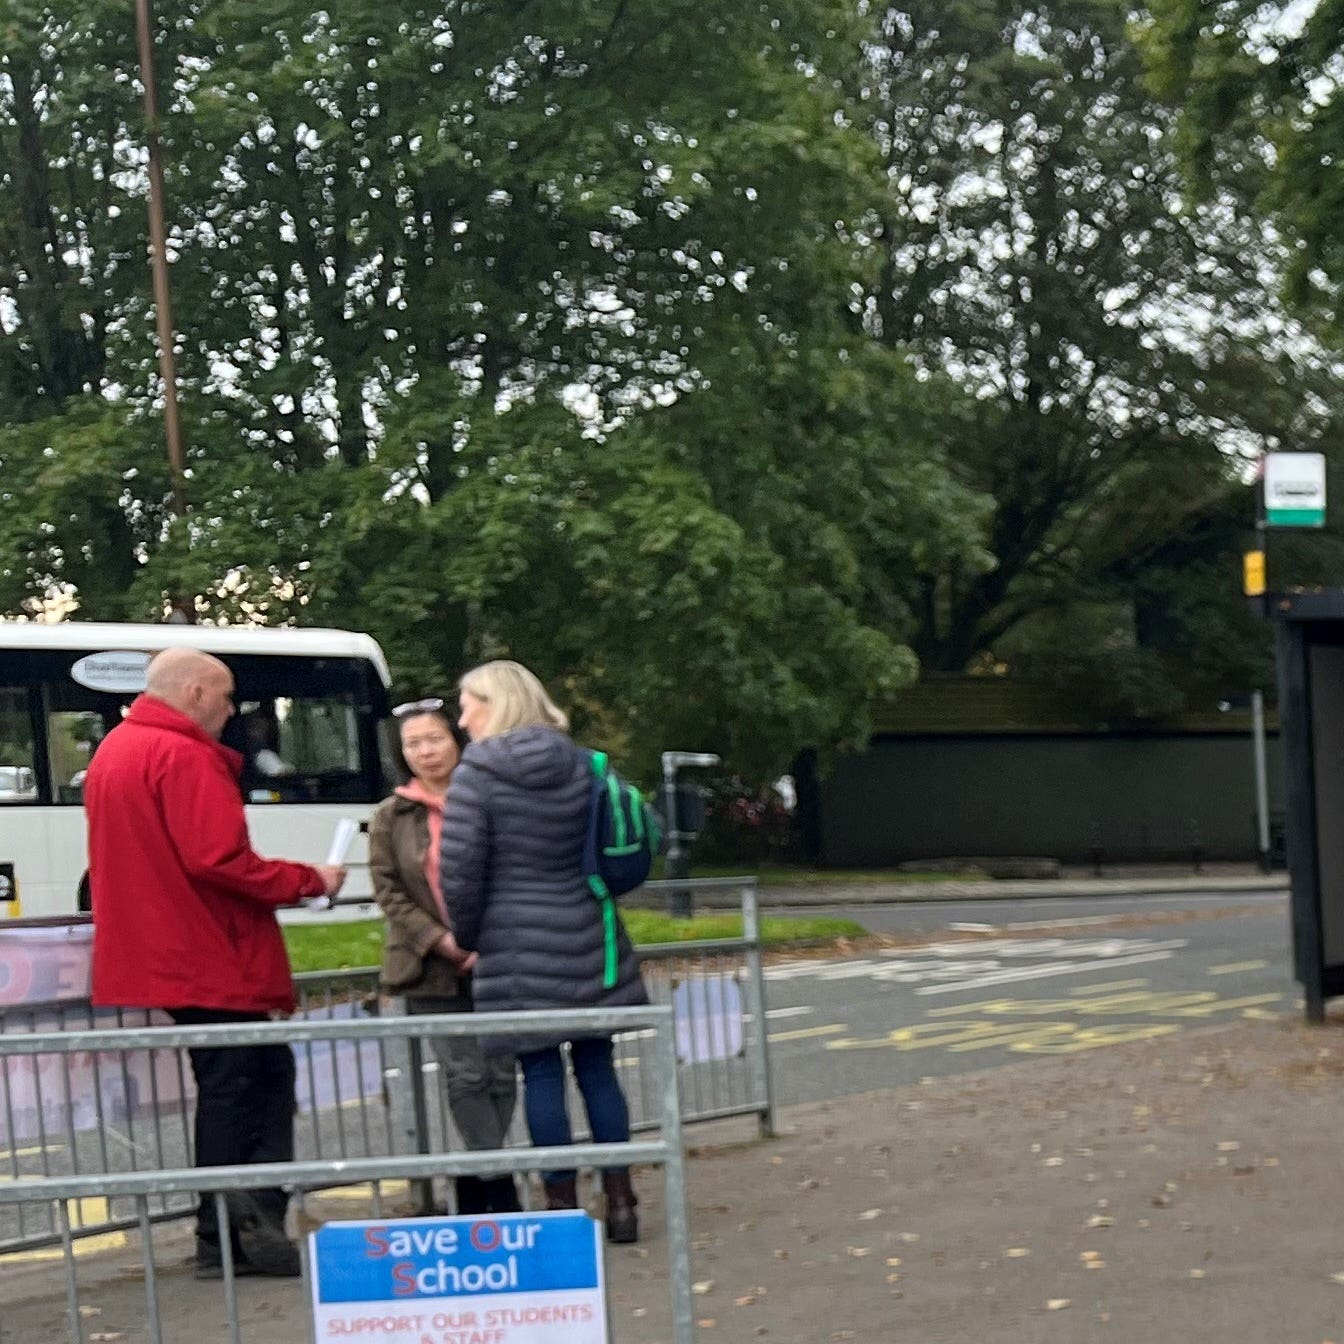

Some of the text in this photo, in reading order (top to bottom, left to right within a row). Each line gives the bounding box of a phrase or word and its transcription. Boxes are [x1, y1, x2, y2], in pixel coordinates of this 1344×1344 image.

[365, 1219, 542, 1258] Save Our
[393, 1256, 518, 1295] School
[327, 1304, 593, 1337] SUPPORT OUR STUDENTS
